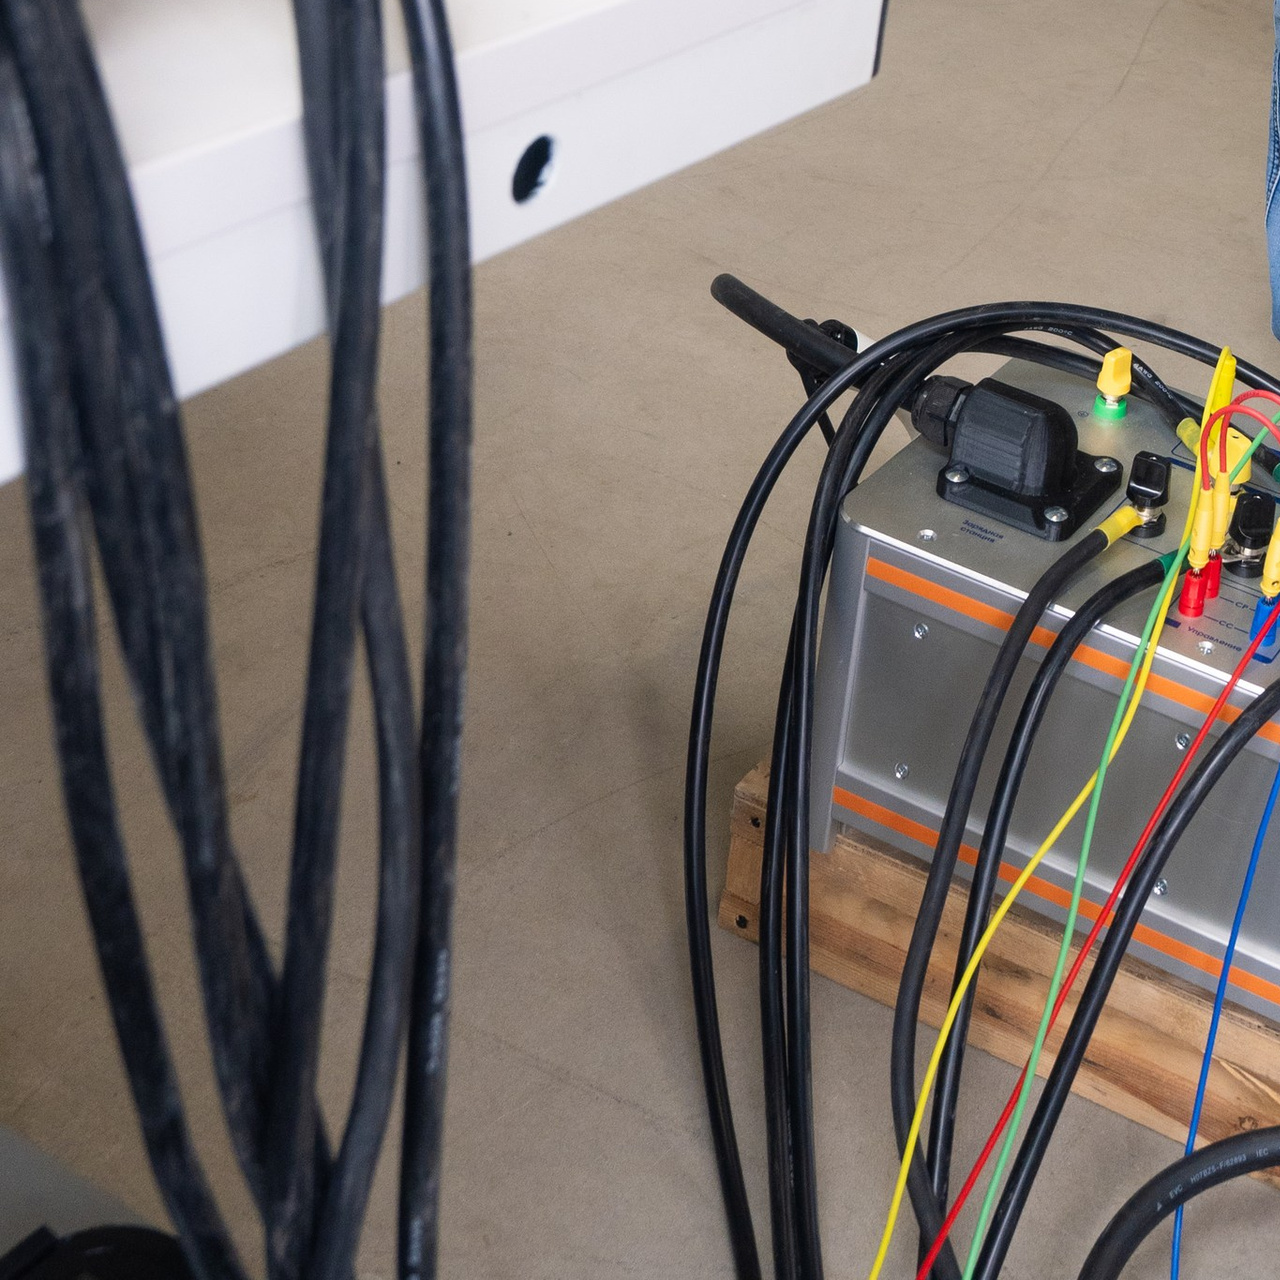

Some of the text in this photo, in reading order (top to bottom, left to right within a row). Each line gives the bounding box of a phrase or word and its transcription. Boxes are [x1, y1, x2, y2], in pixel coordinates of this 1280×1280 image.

[960, 526, 996, 543] станция
[962, 519, 1004, 539] Зарядная
[1188, 625, 1242, 652] Управление
[1168, 1184, 1183, 1199] EVC
[1256, 1148, 1269, 1157] IEC
